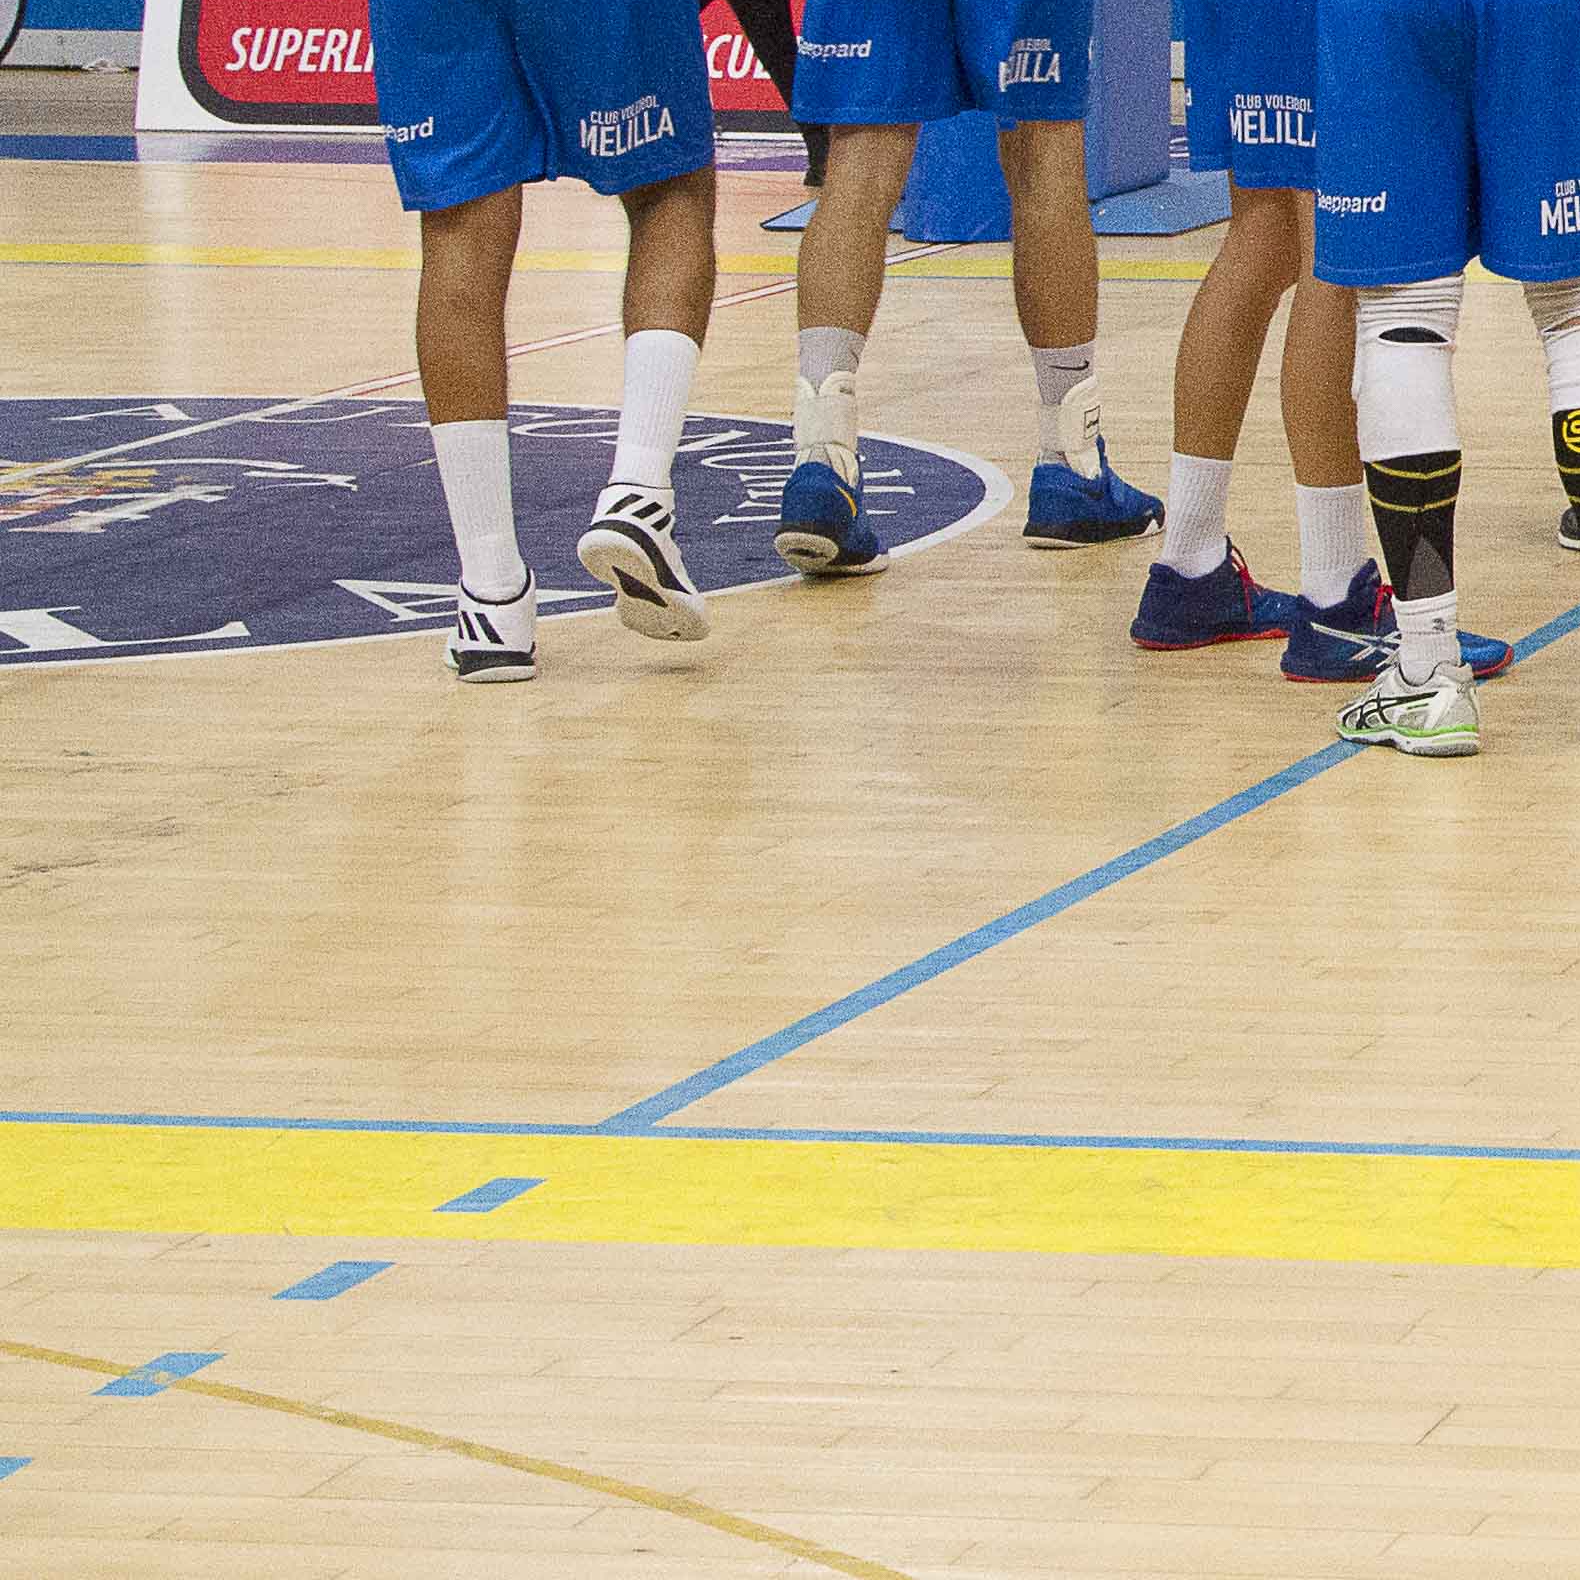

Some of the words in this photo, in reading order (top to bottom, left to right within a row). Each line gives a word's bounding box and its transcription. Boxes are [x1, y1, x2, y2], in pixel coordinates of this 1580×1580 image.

[1234, 92, 1265, 110] CLUB
[579, 106, 675, 158] MELILLA
[1229, 107, 1317, 148] MELILL
